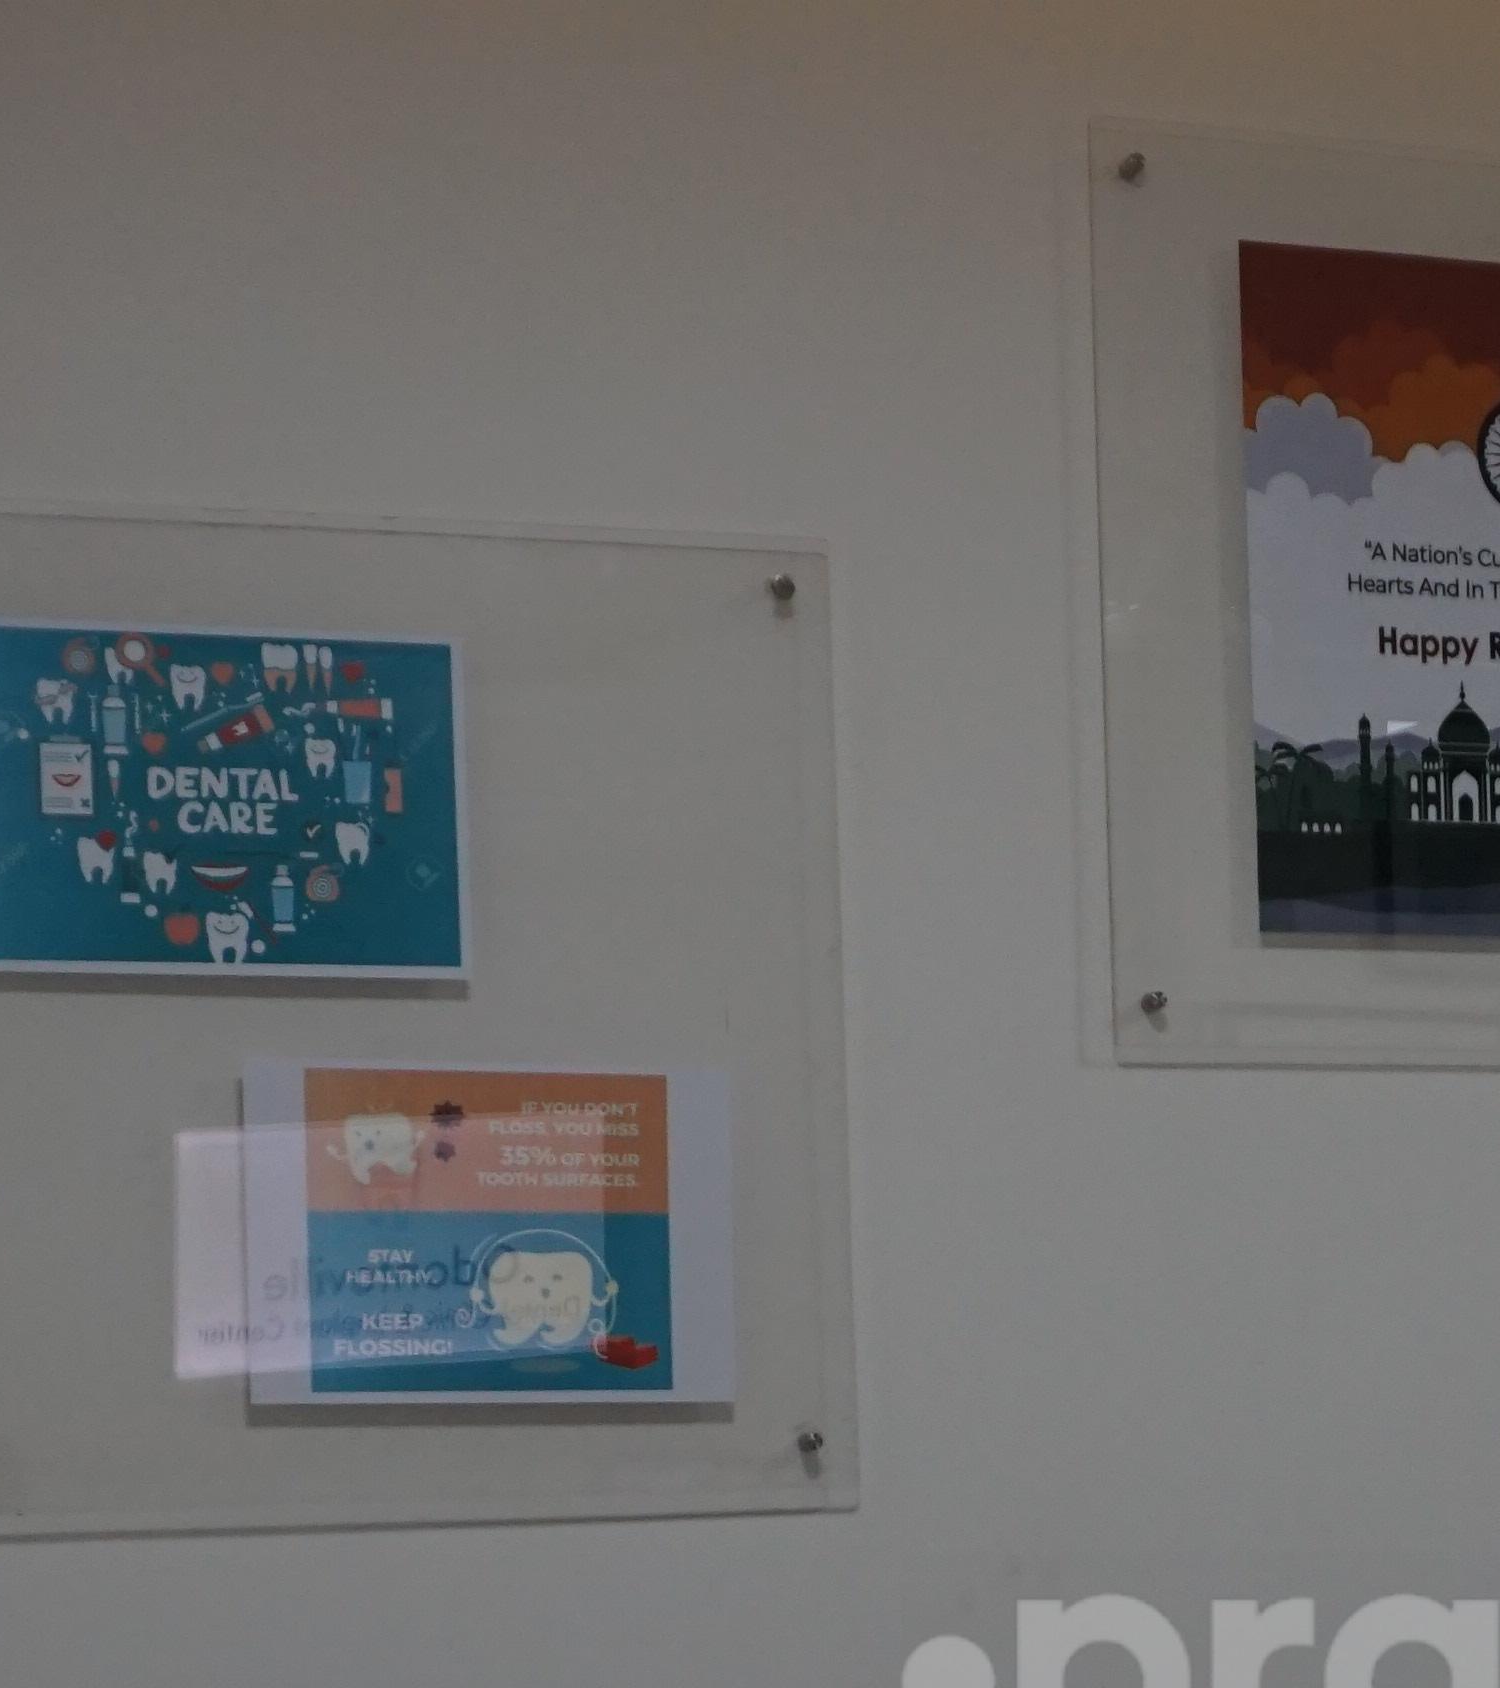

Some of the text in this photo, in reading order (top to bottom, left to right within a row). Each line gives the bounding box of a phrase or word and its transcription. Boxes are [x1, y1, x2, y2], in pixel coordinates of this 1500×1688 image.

[1392, 543, 1472, 566] Nation's
[1347, 573, 1414, 595] Hearts
[1419, 577, 1459, 598] And
[1466, 580, 1484, 599] In
[1378, 626, 1479, 666] Happy
[146, 766, 299, 802] DENTAL
[176, 801, 279, 836] CARE
[542, 1101, 579, 1115] YOU
[584, 1102, 638, 1116] DON'T
[553, 1121, 592, 1136] YOU
[499, 1145, 640, 1167] 35% OF YOUR
[476, 1171, 538, 1186] TOOTH
[368, 1249, 414, 1263] STAY
[362, 1313, 423, 1331] KEEP
[333, 1338, 454, 1356] FLOSSING!
